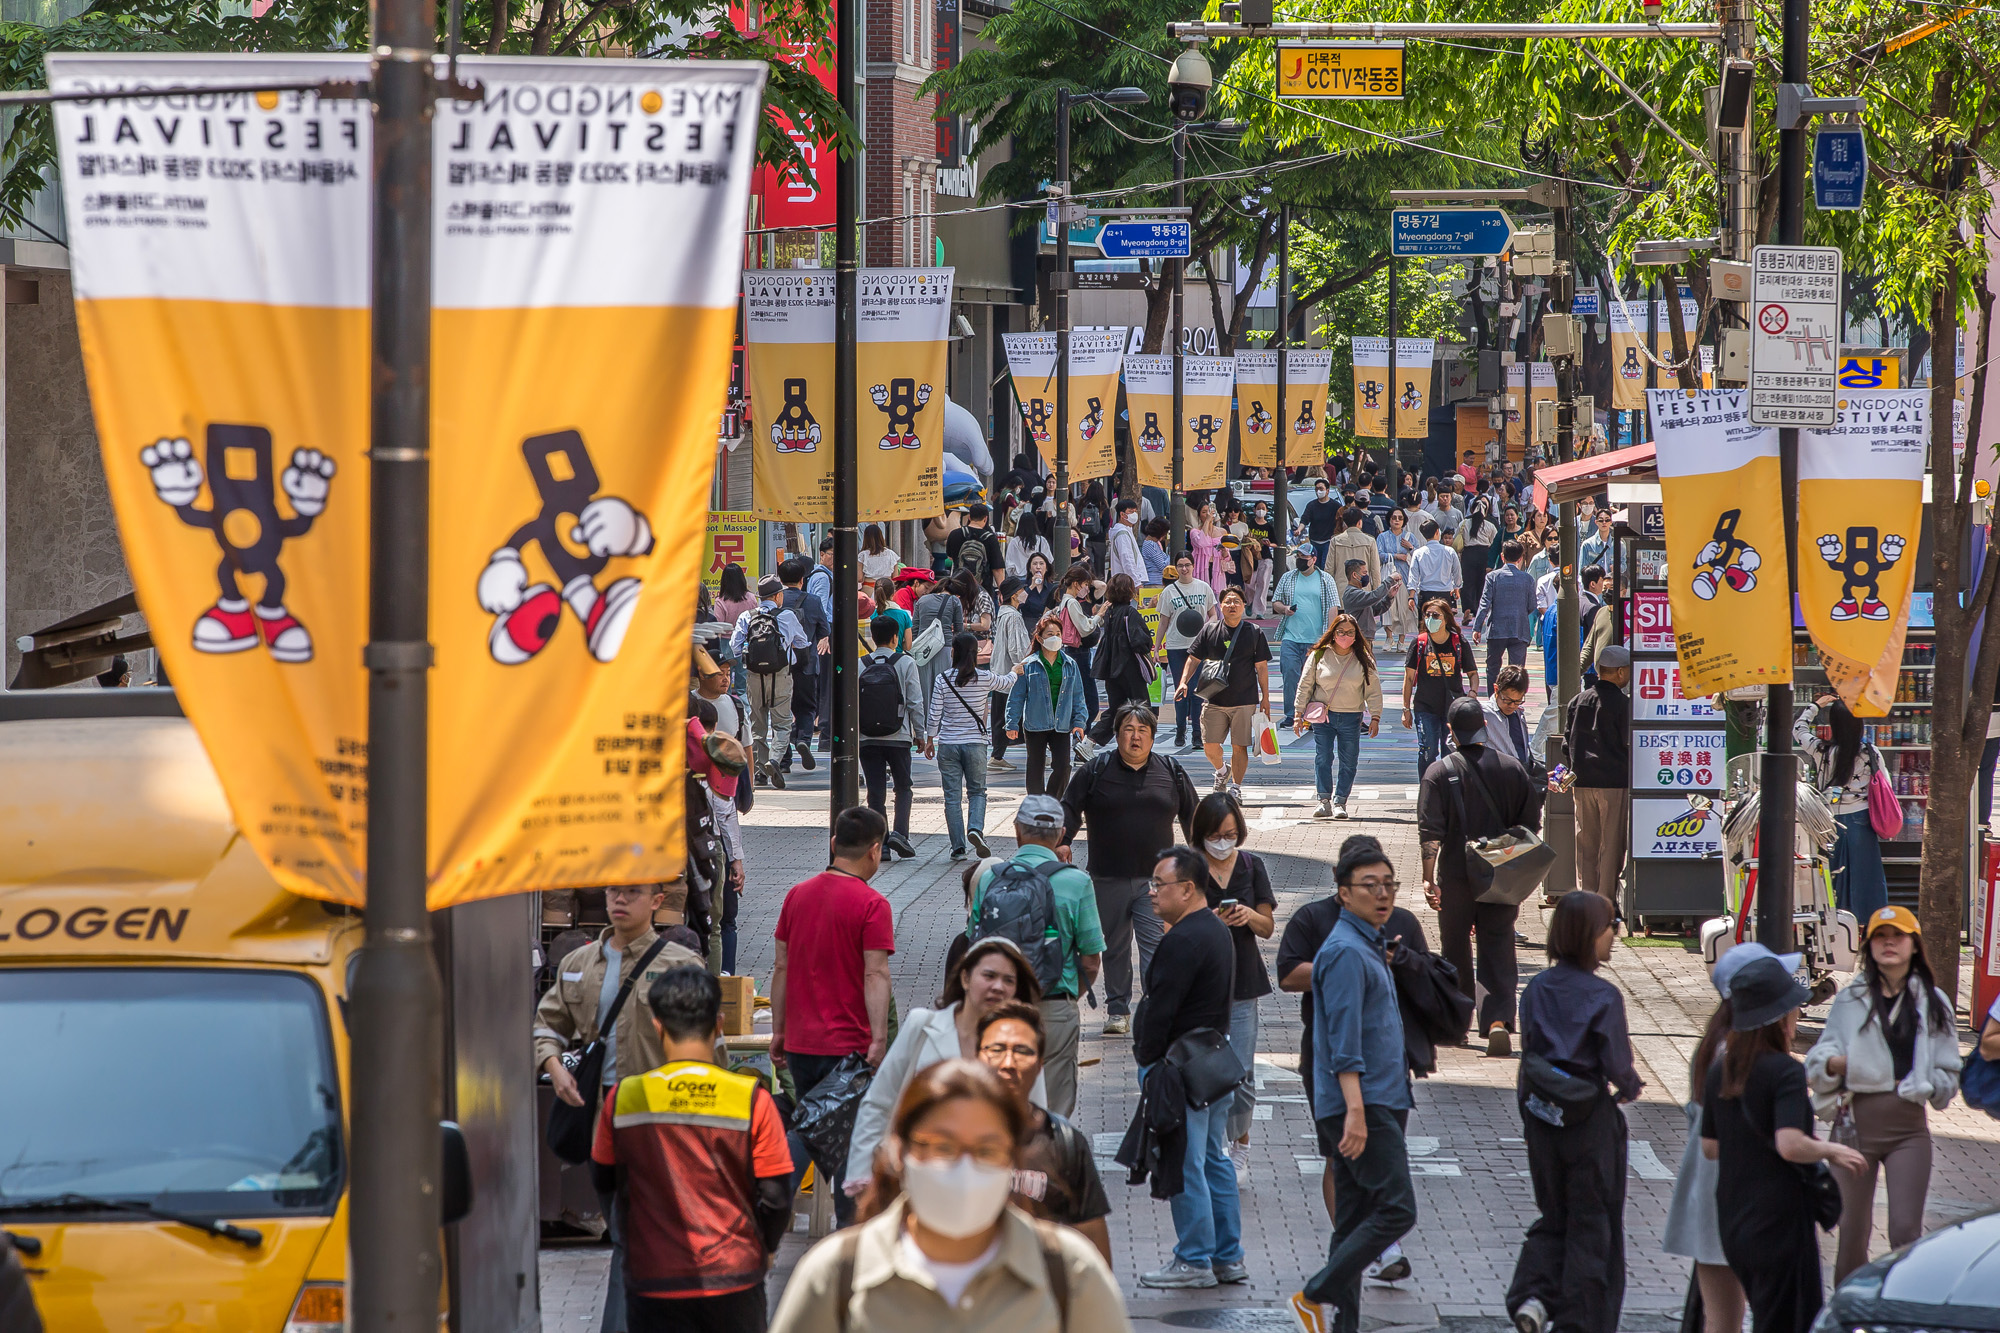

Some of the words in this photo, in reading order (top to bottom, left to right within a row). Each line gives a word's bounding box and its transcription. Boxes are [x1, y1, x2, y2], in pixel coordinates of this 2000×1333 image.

[1307, 53, 1341, 66] 다목적
[1307, 67, 1399, 92] CCTV작동중
[1398, 214, 1440, 229] 명동7길
[1152, 225, 1187, 237] 명동8길
[1398, 232, 1452, 242] Myeongdong
[1455, 232, 1474, 241] 7-gil
[1121, 239, 1168, 247] Myeongdong
[1170, 239, 1187, 247] 8-gil
[1760, 253, 1835, 271] 통행금지(제한)알림
[1807, 276, 1834, 287] 모든차량
[1838, 359, 1887, 388] 상
[1756, 376, 1770, 386] 구간
[1818, 378, 1832, 387] 일대
[1657, 396, 1740, 416] FESTIV
[1837, 398, 1923, 410] ONGDONG
[1660, 416, 1700, 429] 서울페스타
[1702, 414, 1723, 425] 2023
[1724, 412, 1740, 423] 명동
[1761, 410, 1824, 421] 남대문경찰서장
[1837, 410, 1923, 423] STIVAL
[1849, 426, 1870, 434] 2023
[1872, 426, 1888, 434] 명동
[1890, 425, 1923, 435] 페스티벌
[722, 515, 757, 523] HELLO
[723, 524, 757, 533] Massage
[1656, 704, 1680, 716] 사고
[1638, 735, 1680, 748] BEST
[1656, 817, 1705, 837] toto
[1650, 841, 1718, 854] 스포츠토토
